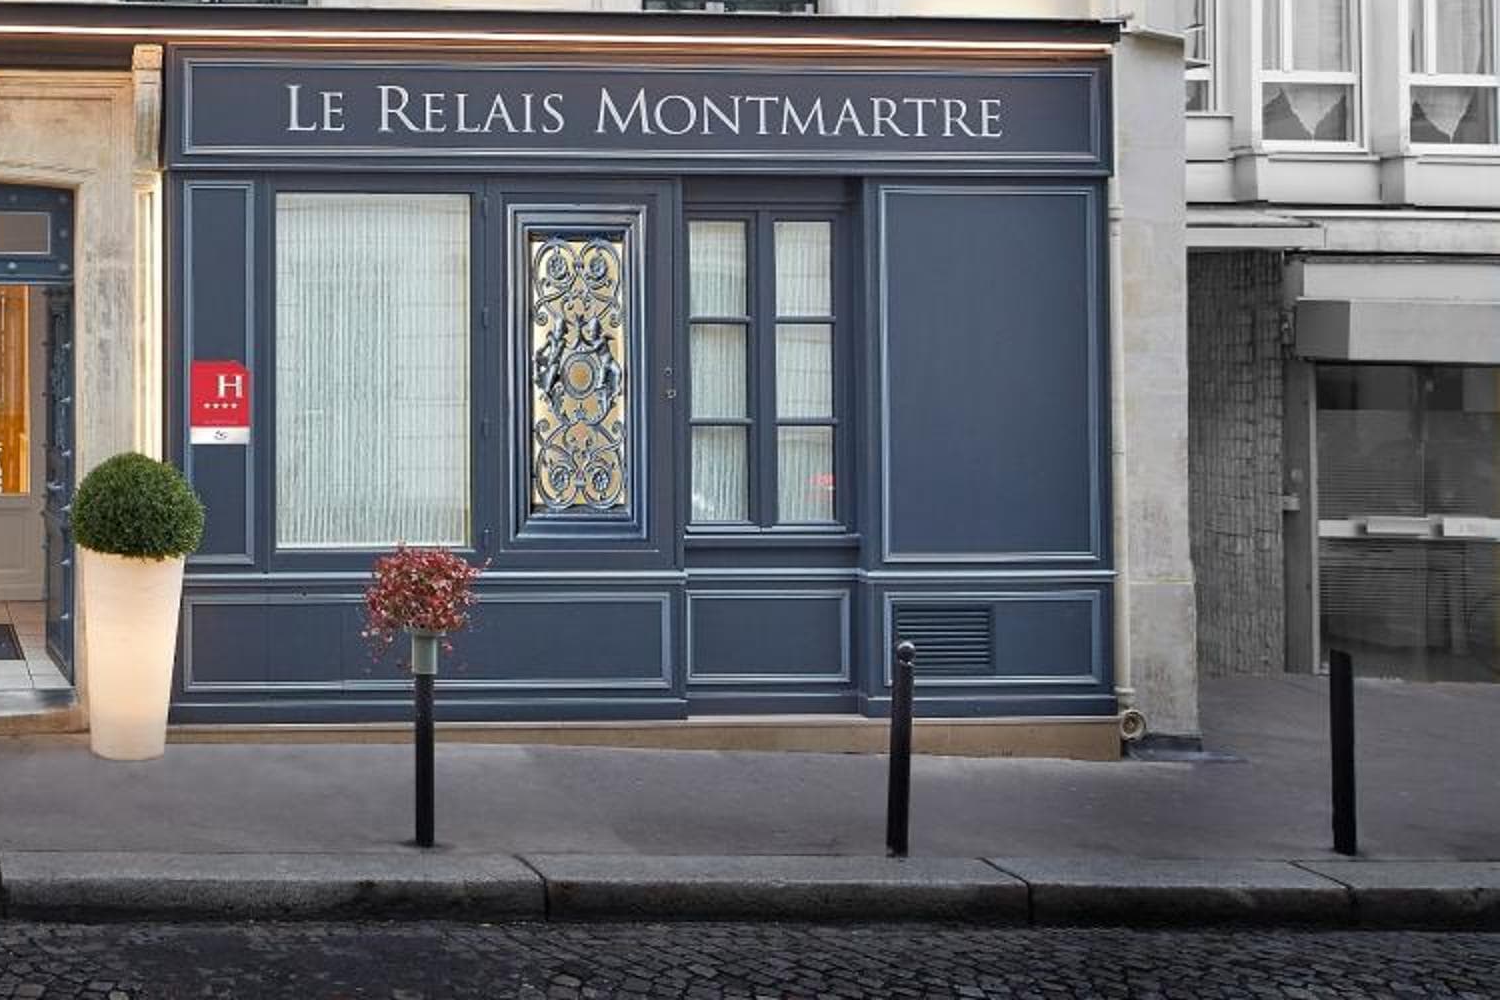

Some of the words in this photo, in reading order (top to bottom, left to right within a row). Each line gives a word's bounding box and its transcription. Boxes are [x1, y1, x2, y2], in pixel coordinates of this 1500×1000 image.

[285, 84, 347, 133] LE
[376, 84, 566, 134] RELAIS
[595, 87, 1004, 137] MONTMARTRE
[217, 374, 243, 399] H
